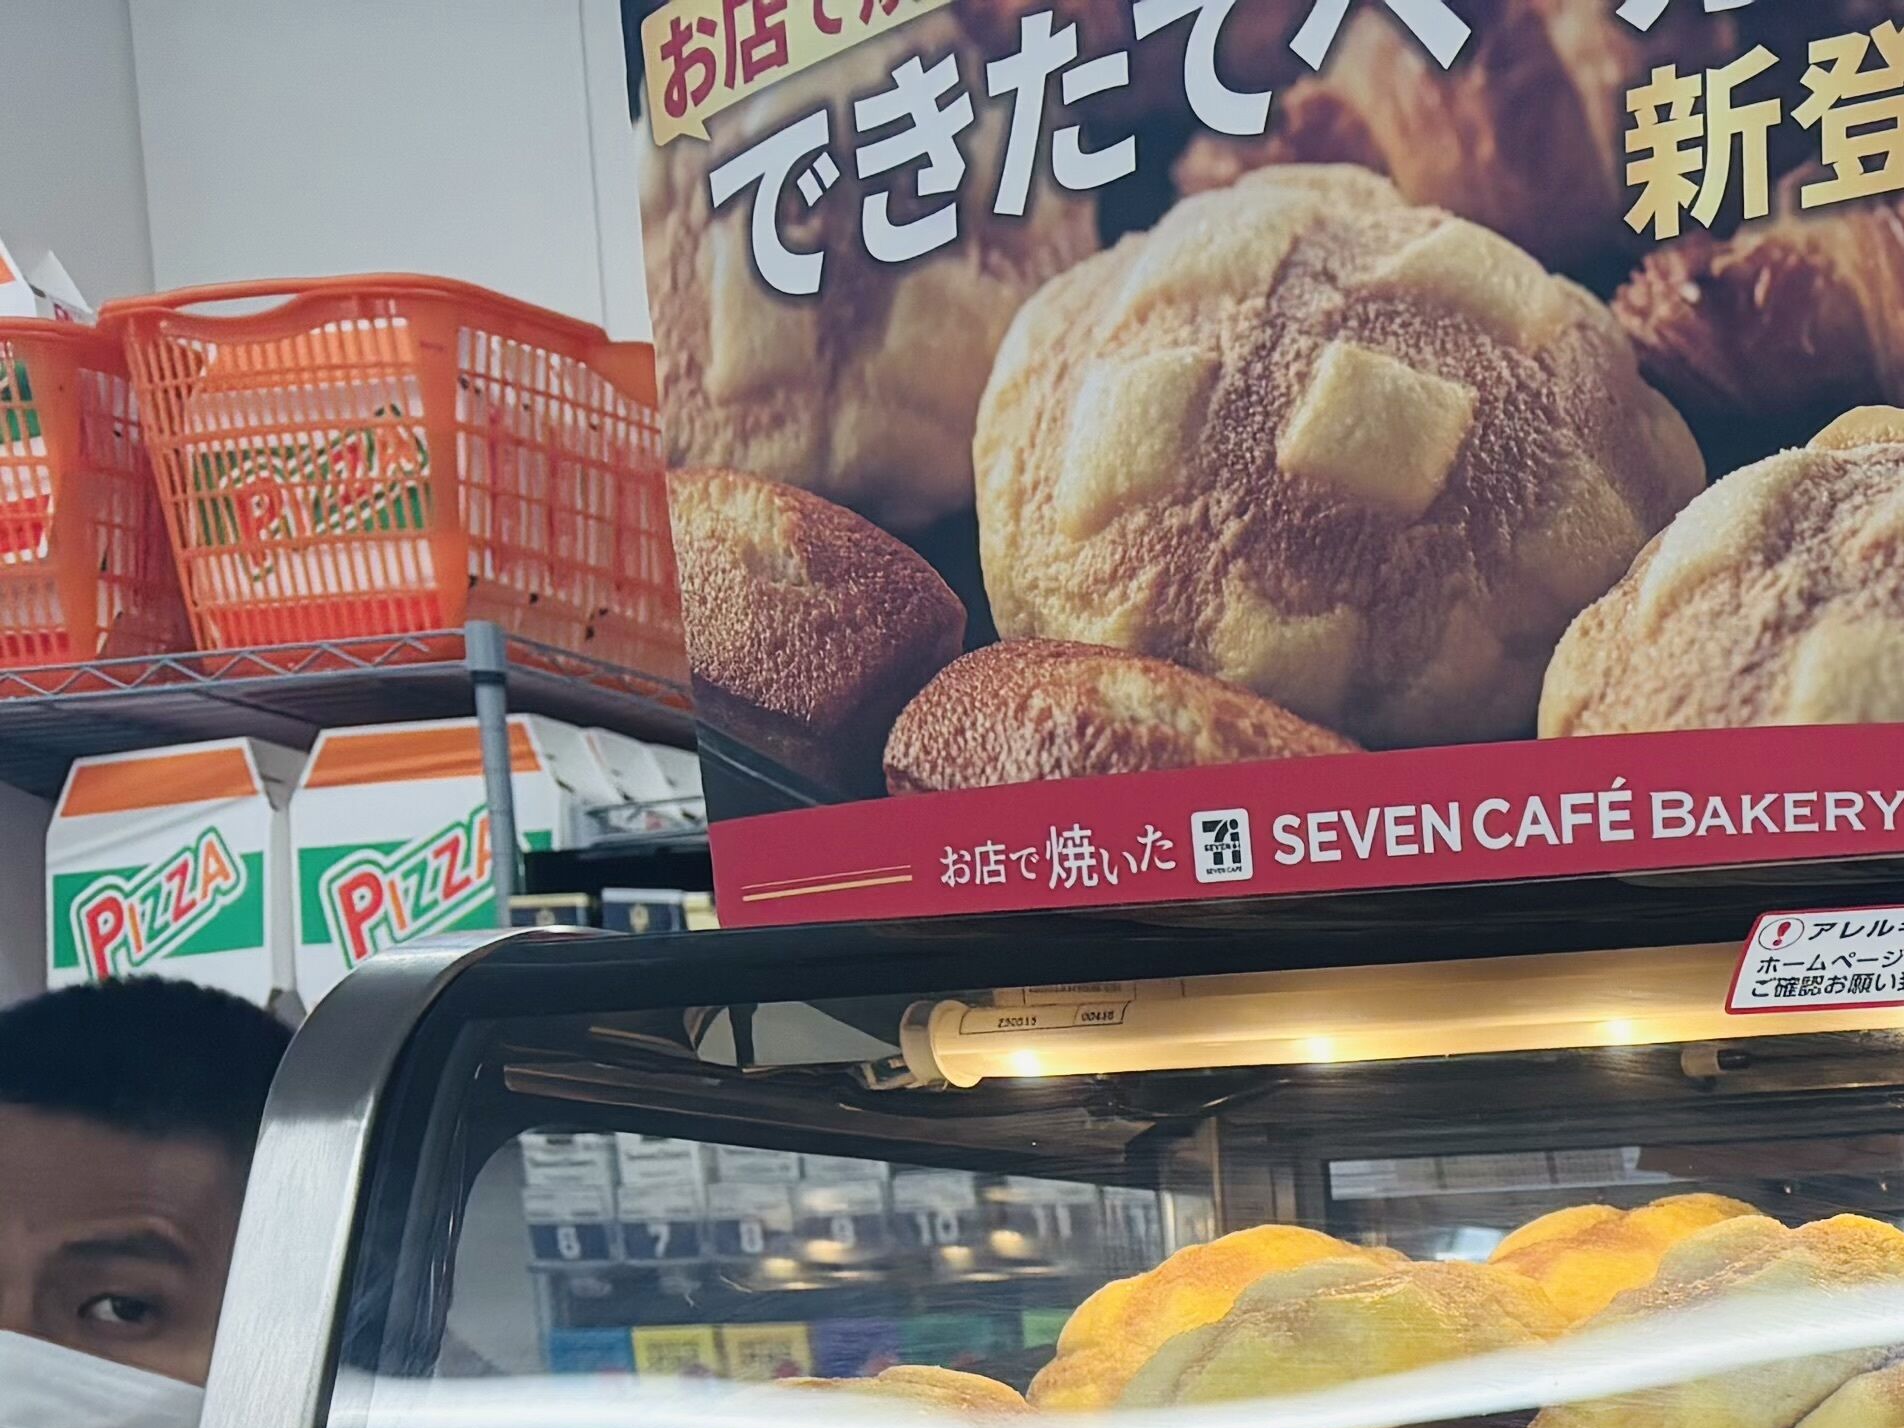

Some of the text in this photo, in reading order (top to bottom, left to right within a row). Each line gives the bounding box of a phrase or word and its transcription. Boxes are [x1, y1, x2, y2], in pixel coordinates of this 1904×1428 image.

[939, 823, 1177, 890] お店で焼いた
[1273, 799, 1462, 865] SEVEN
[1472, 779, 1633, 850] CAFÉ
[84, 838, 239, 978] PIZZA
